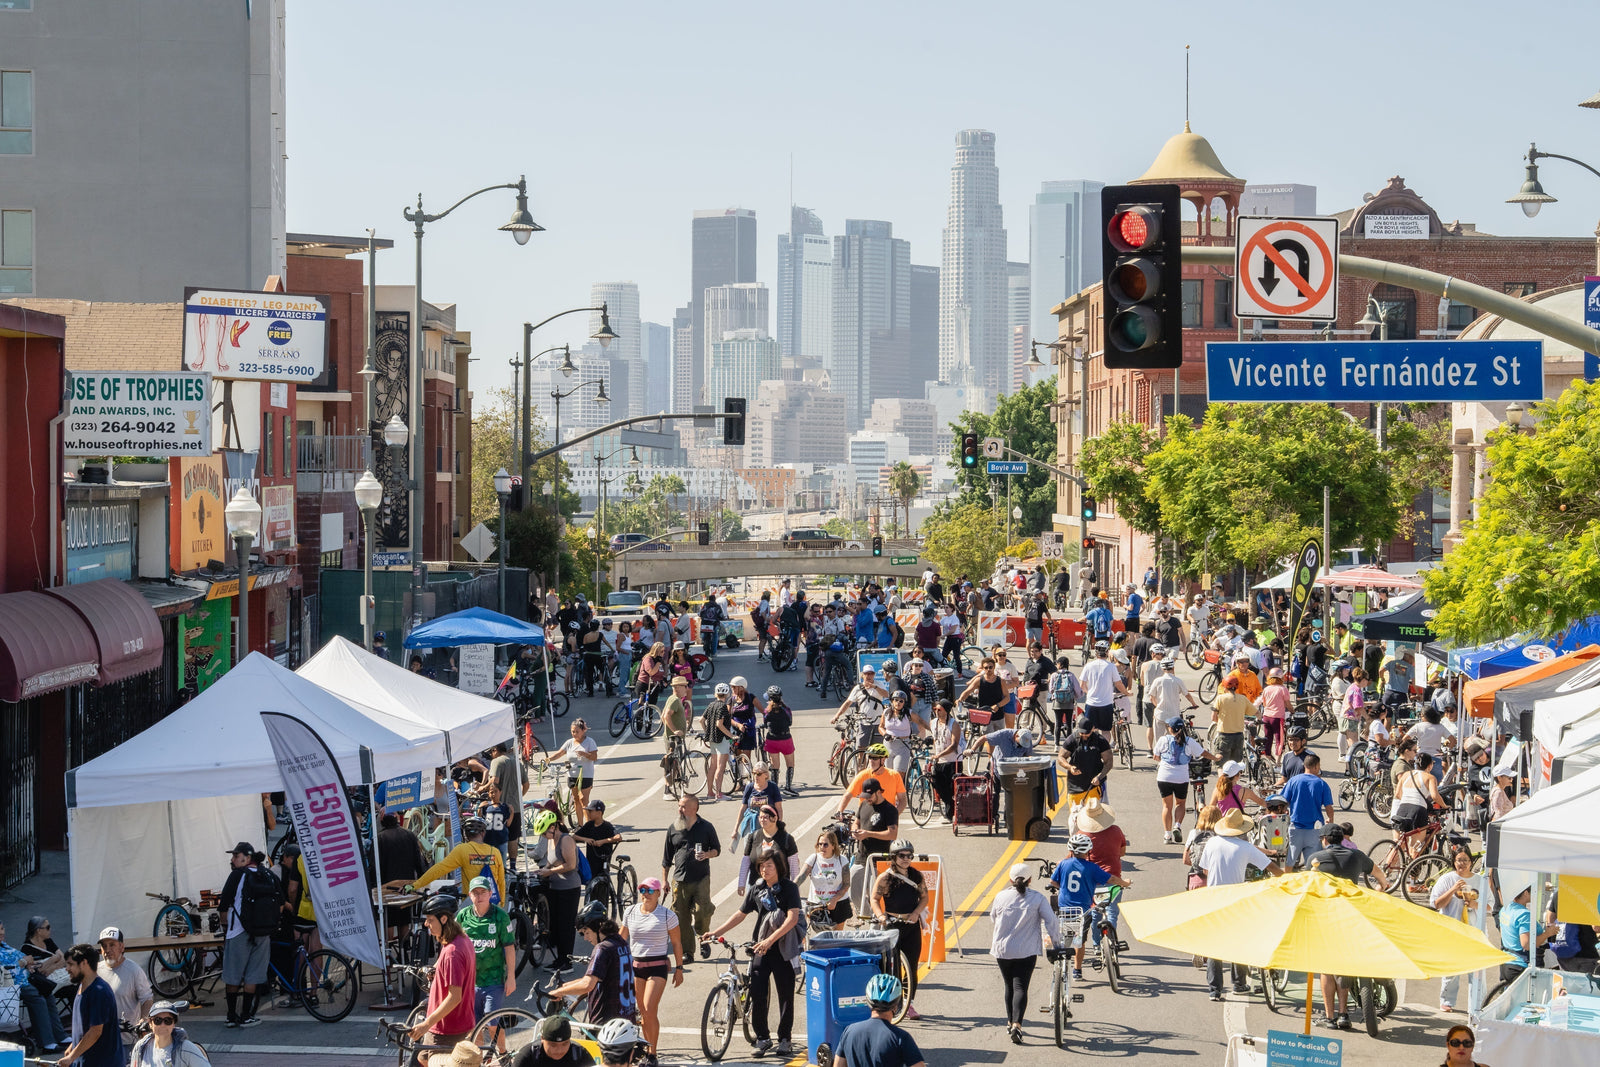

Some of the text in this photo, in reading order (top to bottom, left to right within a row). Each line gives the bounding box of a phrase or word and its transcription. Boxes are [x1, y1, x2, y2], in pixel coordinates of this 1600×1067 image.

[200, 297, 318, 311] DIABETES? LEG PAIN?
[235, 309, 268, 317] ULCERS
[275, 311, 316, 319] VARICES?
[268, 331, 291, 339] FREE
[258, 349, 300, 359] SERRANO
[239, 363, 314, 376] 323-585-6900
[1228, 355, 1521, 386] Vicente Fernández St
[101, 377, 120, 400] OF
[126, 378, 203, 401] TROPHIES
[72, 406, 175, 416] AND AWARDS, INC.
[71, 422, 175, 433] (323) 264-9042
[65, 440, 202, 451] w.houseoftrophies.net
[991, 464, 1009, 472] Boyle
[91, 506, 100, 546] OF
[101, 504, 130, 544] TROPHIES
[192, 539, 213, 553] KITCHEN
[1399, 626, 1426, 635] TREE
[280, 758, 293, 767] FULL
[311, 760, 326, 769] SHOP
[292, 802, 321, 879] BICYCLE SHOP
[305, 782, 359, 888] ESQUINA
[1068, 870, 1081, 892] 6
[324, 897, 355, 910] BICYCLES
[328, 907, 355, 919] REPAIRS
[333, 918, 354, 928] PARTS
[325, 925, 367, 940] ACCESSORIES
[1271, 1038, 1287, 1046] How
[1297, 1041, 1325, 1051] Pedicab
[1271, 1051, 1289, 1059] Cómo
[1314, 1058, 1338, 1066] Bicitaxi
